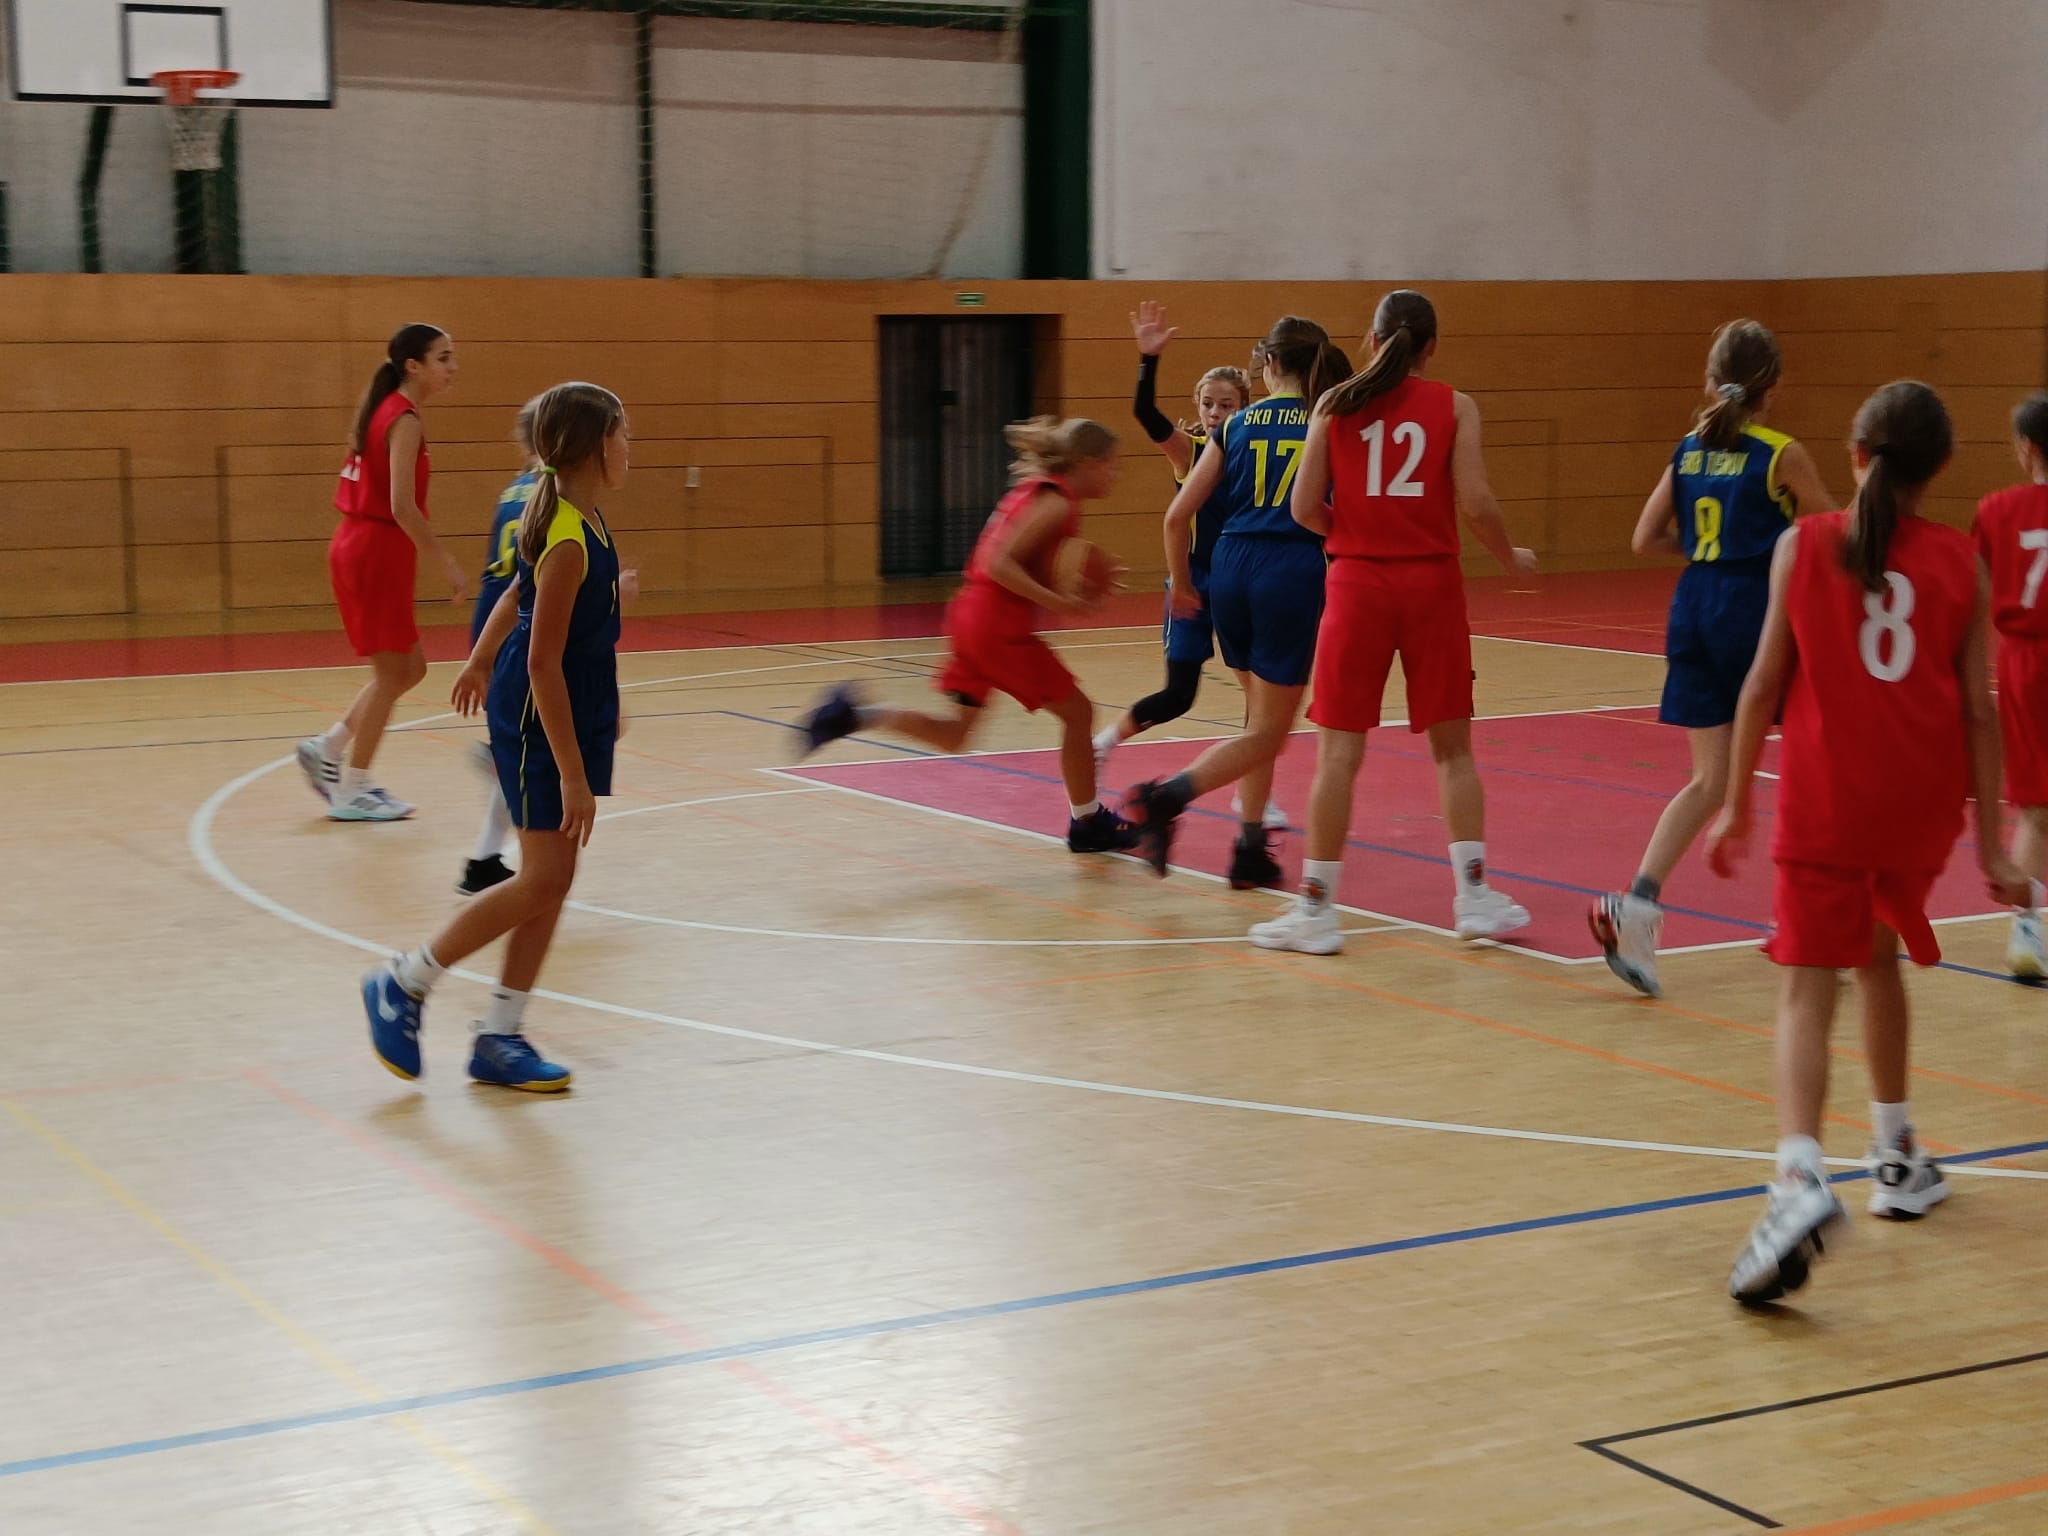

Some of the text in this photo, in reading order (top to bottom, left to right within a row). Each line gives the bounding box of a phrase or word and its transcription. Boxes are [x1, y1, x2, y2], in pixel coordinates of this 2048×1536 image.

[1277, 407, 1309, 425] TIŠN
[1250, 439, 1306, 508] 17
[1360, 419, 1427, 497] 12
[1692, 495, 1722, 562] 8
[2018, 528, 2048, 609] 7
[1858, 570, 1916, 683] 8
